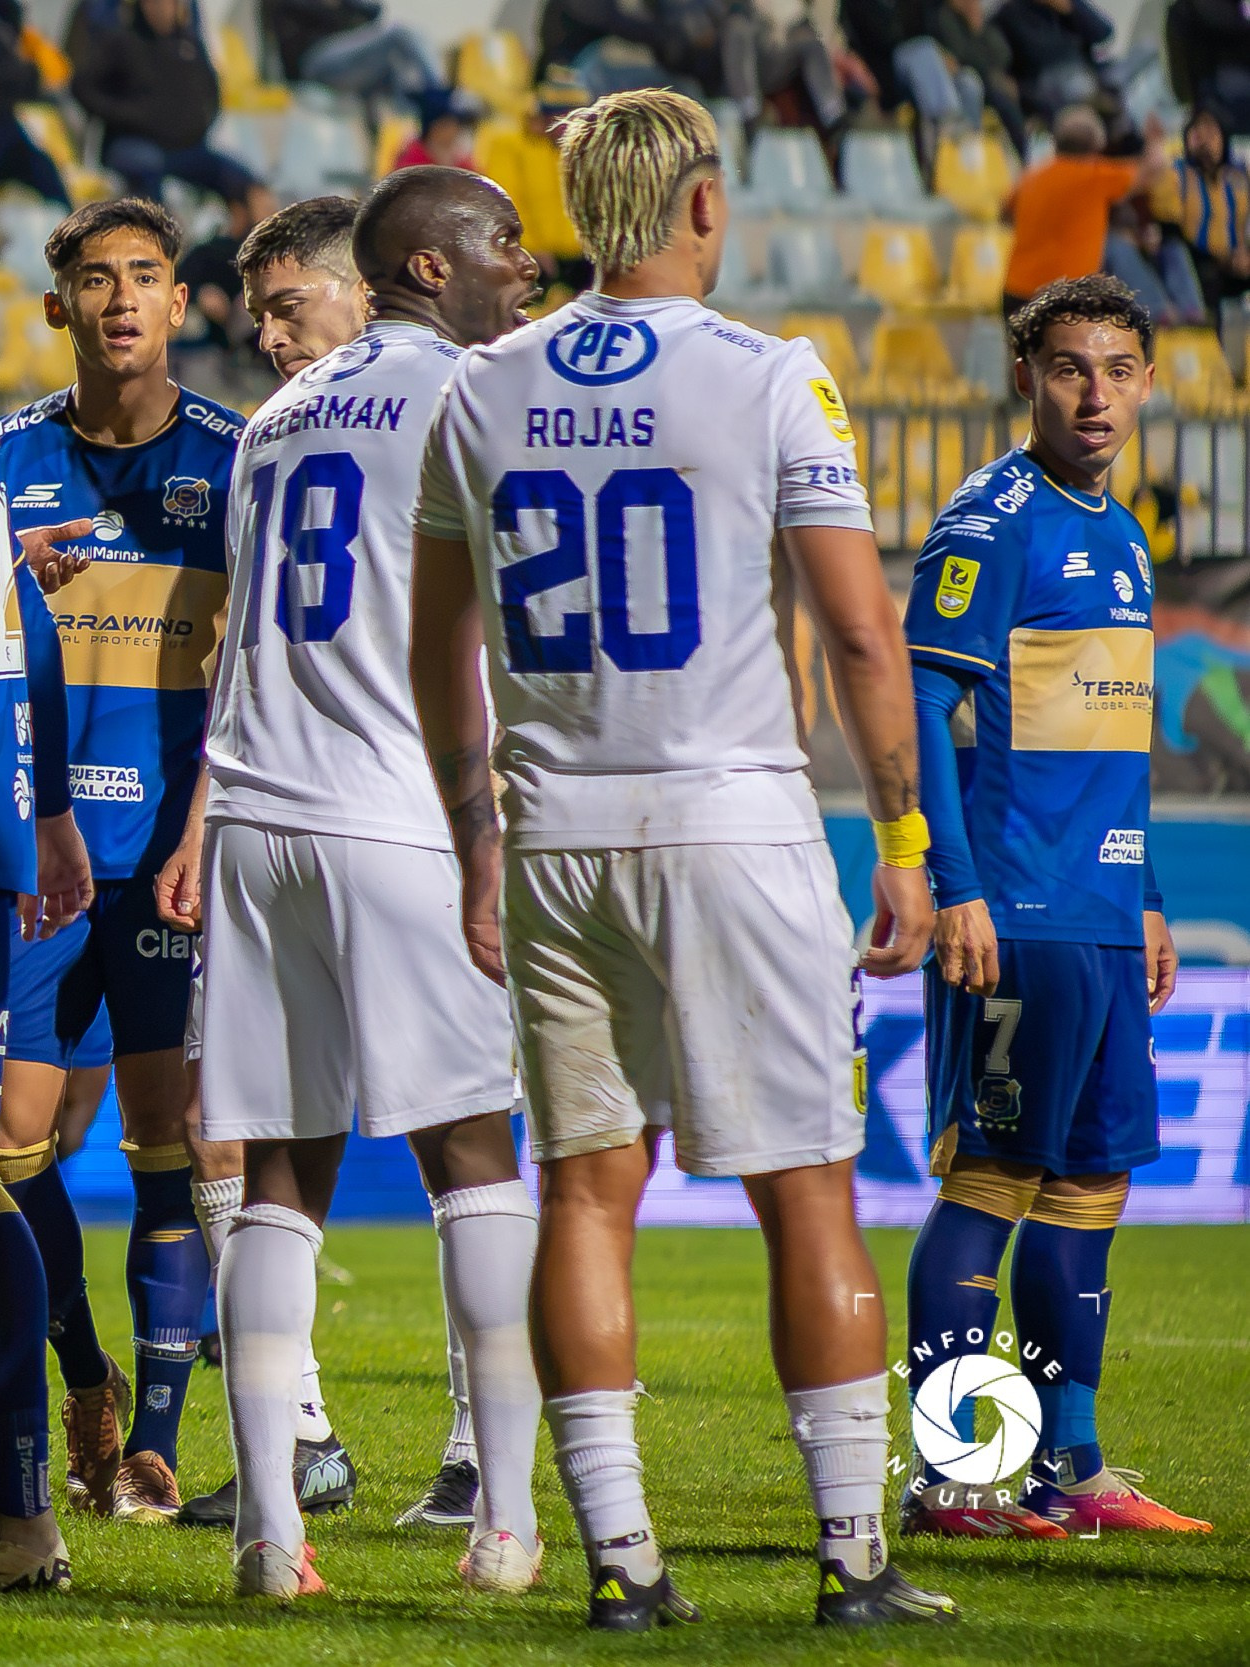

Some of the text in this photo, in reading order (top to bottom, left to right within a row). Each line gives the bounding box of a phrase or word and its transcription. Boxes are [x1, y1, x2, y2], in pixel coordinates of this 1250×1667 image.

[525, 407, 656, 448] ROJAS
[994, 476, 1035, 515] Claro
[239, 451, 366, 647] 18
[491, 467, 702, 674] 20
[51, 614, 194, 636] RRAWIND
[68, 769, 137, 783] PUESTAS
[69, 784, 141, 799] YAL.COM
[983, 999, 1022, 1075] 7
